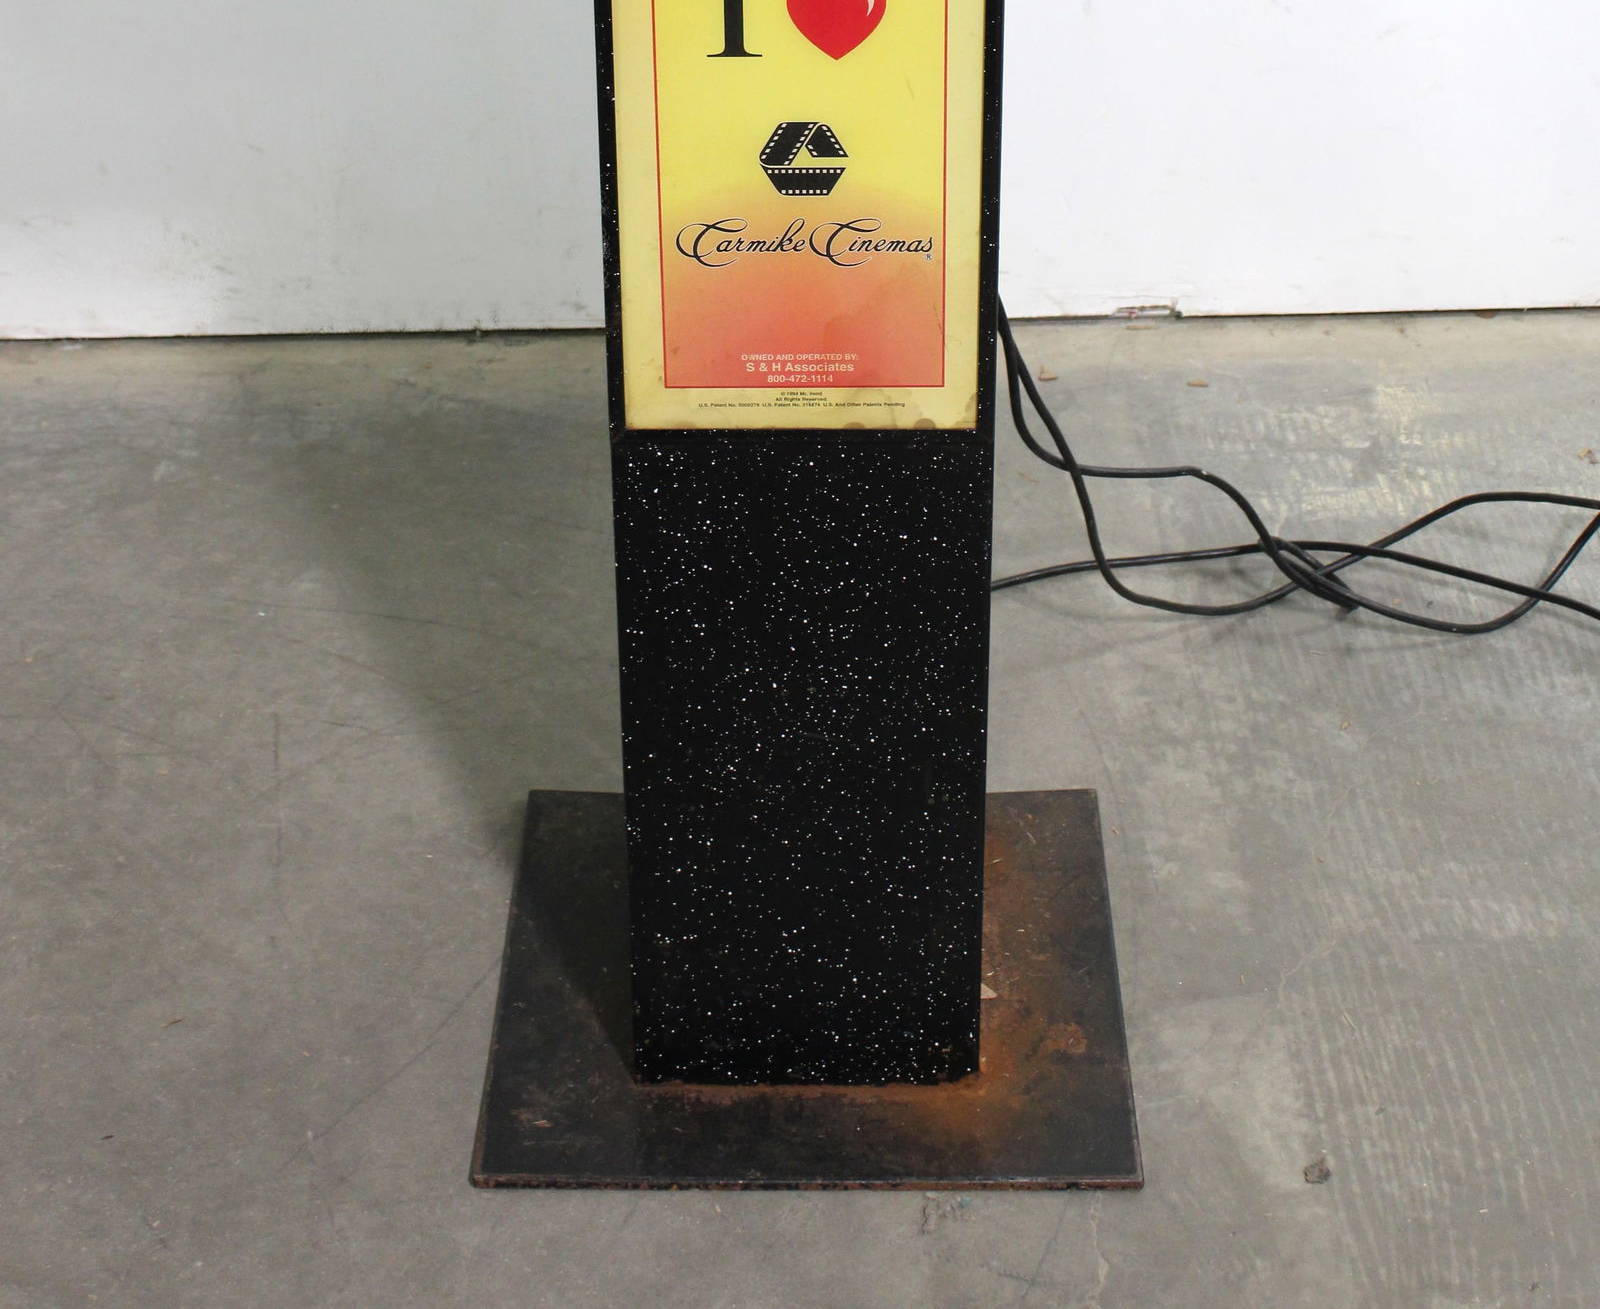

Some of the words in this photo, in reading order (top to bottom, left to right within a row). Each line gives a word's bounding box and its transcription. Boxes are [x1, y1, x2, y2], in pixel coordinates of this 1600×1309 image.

[676, 217, 806, 268] Carmike
[808, 217, 934, 268] Cinemas
[746, 362, 756, 372] S
[759, 362, 768, 372] &
[772, 362, 781, 372] H
[785, 362, 855, 372] Associates
[767, 375, 834, 383] 800-472-1114
